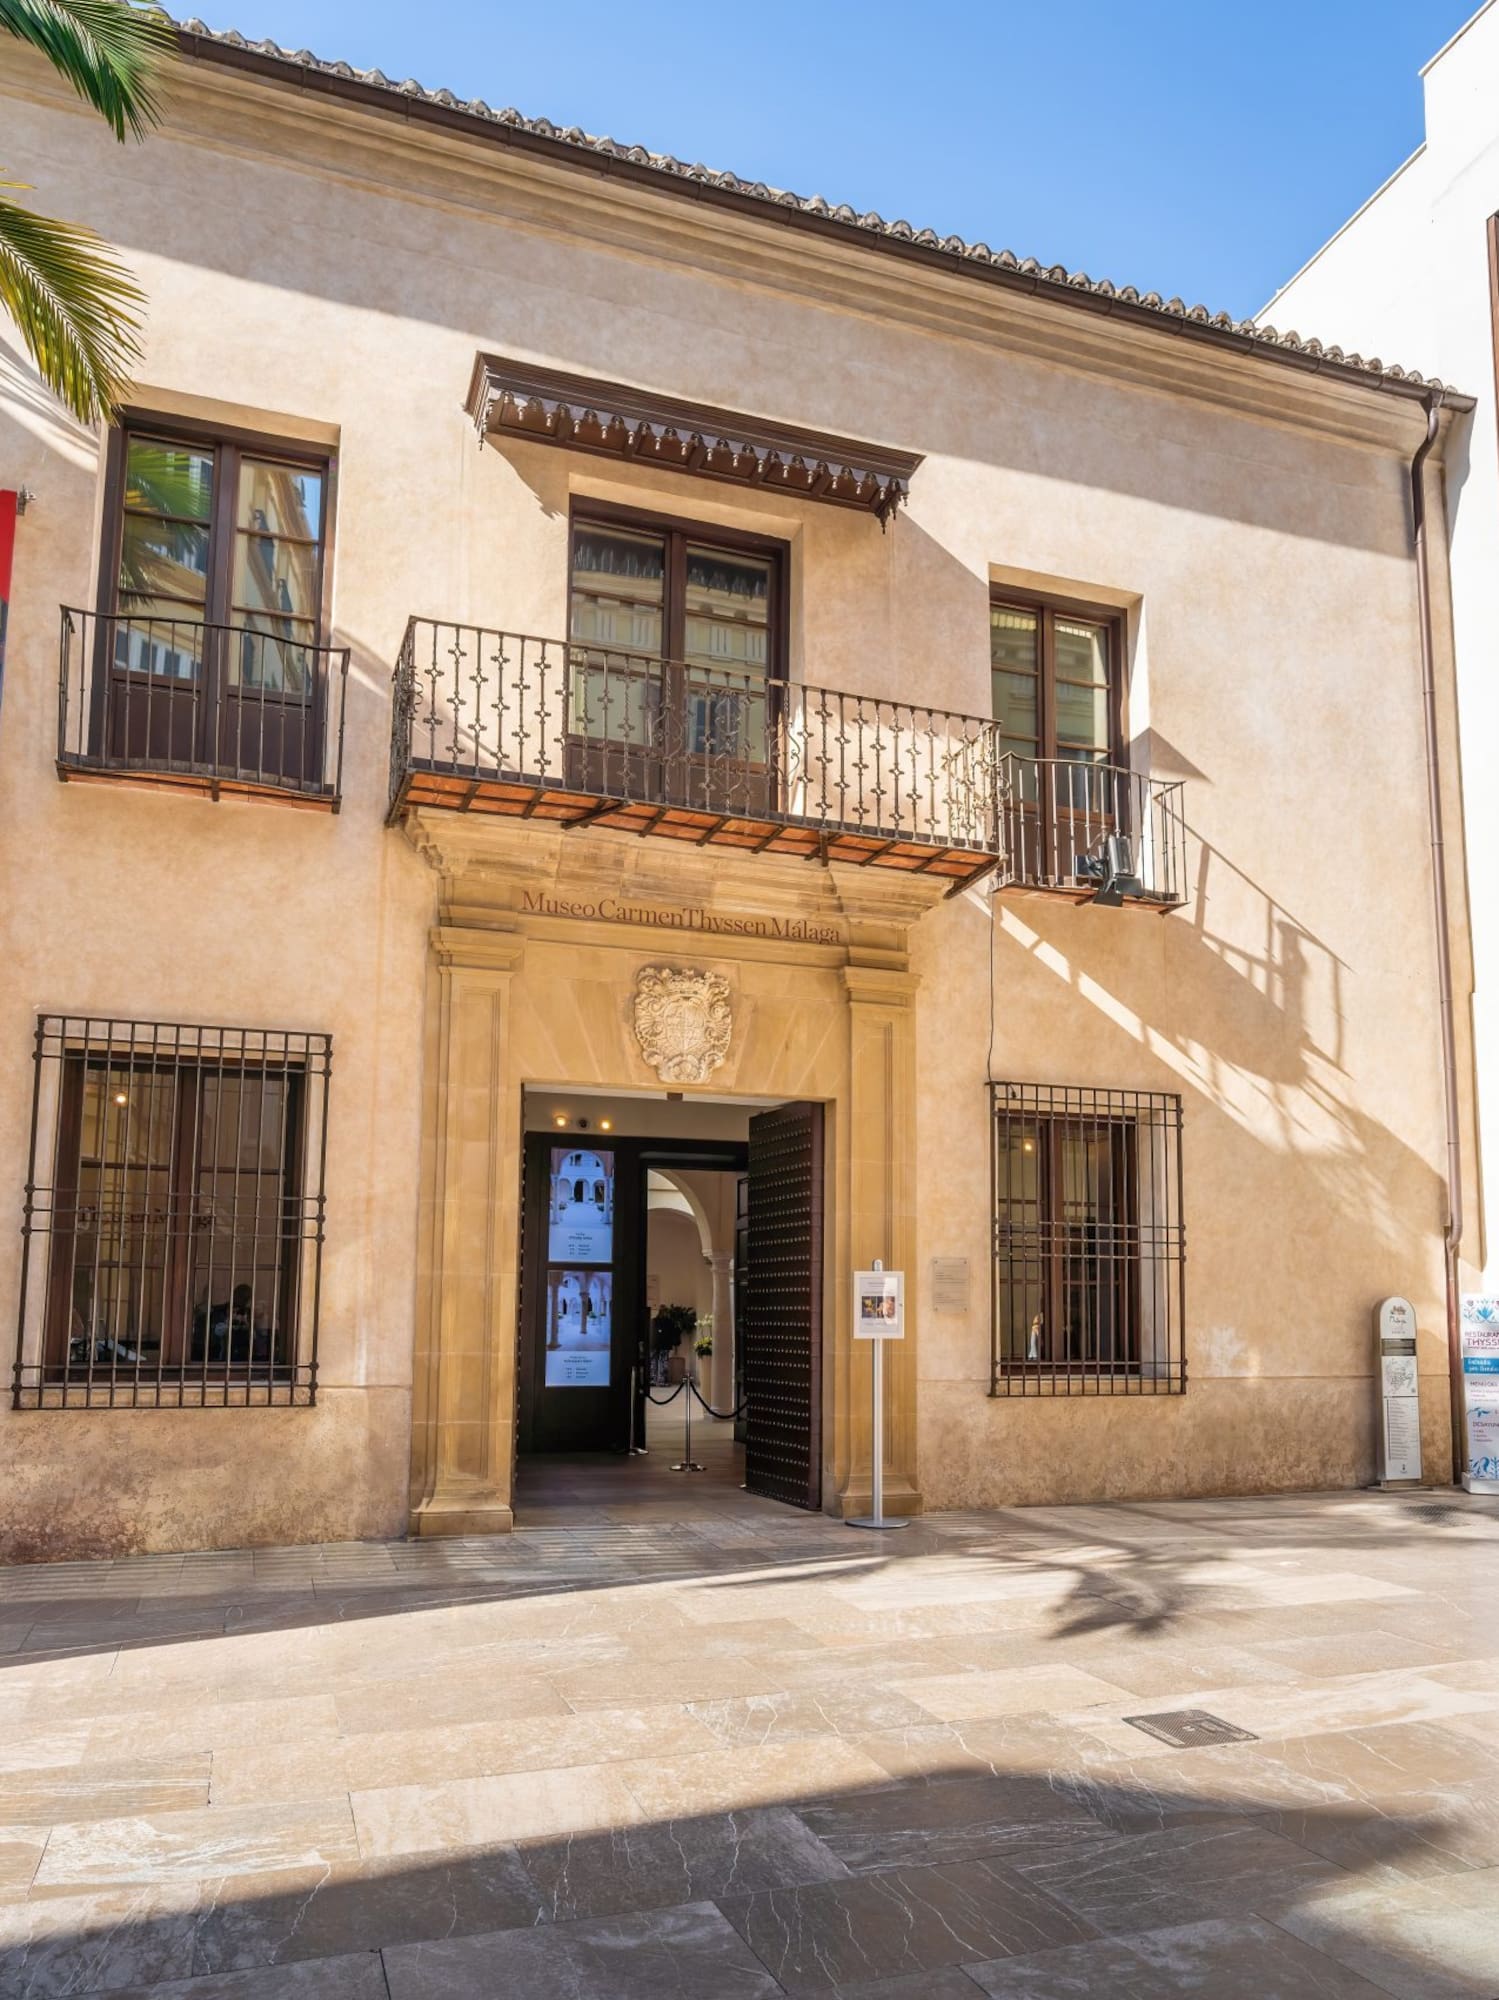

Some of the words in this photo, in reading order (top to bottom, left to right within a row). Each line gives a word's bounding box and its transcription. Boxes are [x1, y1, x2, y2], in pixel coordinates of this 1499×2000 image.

[521, 890, 596, 918] Museo
[598, 898, 684, 927] Carmen
[682, 907, 767, 935] Thyssen
[770, 917, 841, 944] Málaga
[1465, 1338, 1499, 1346] THYSS
